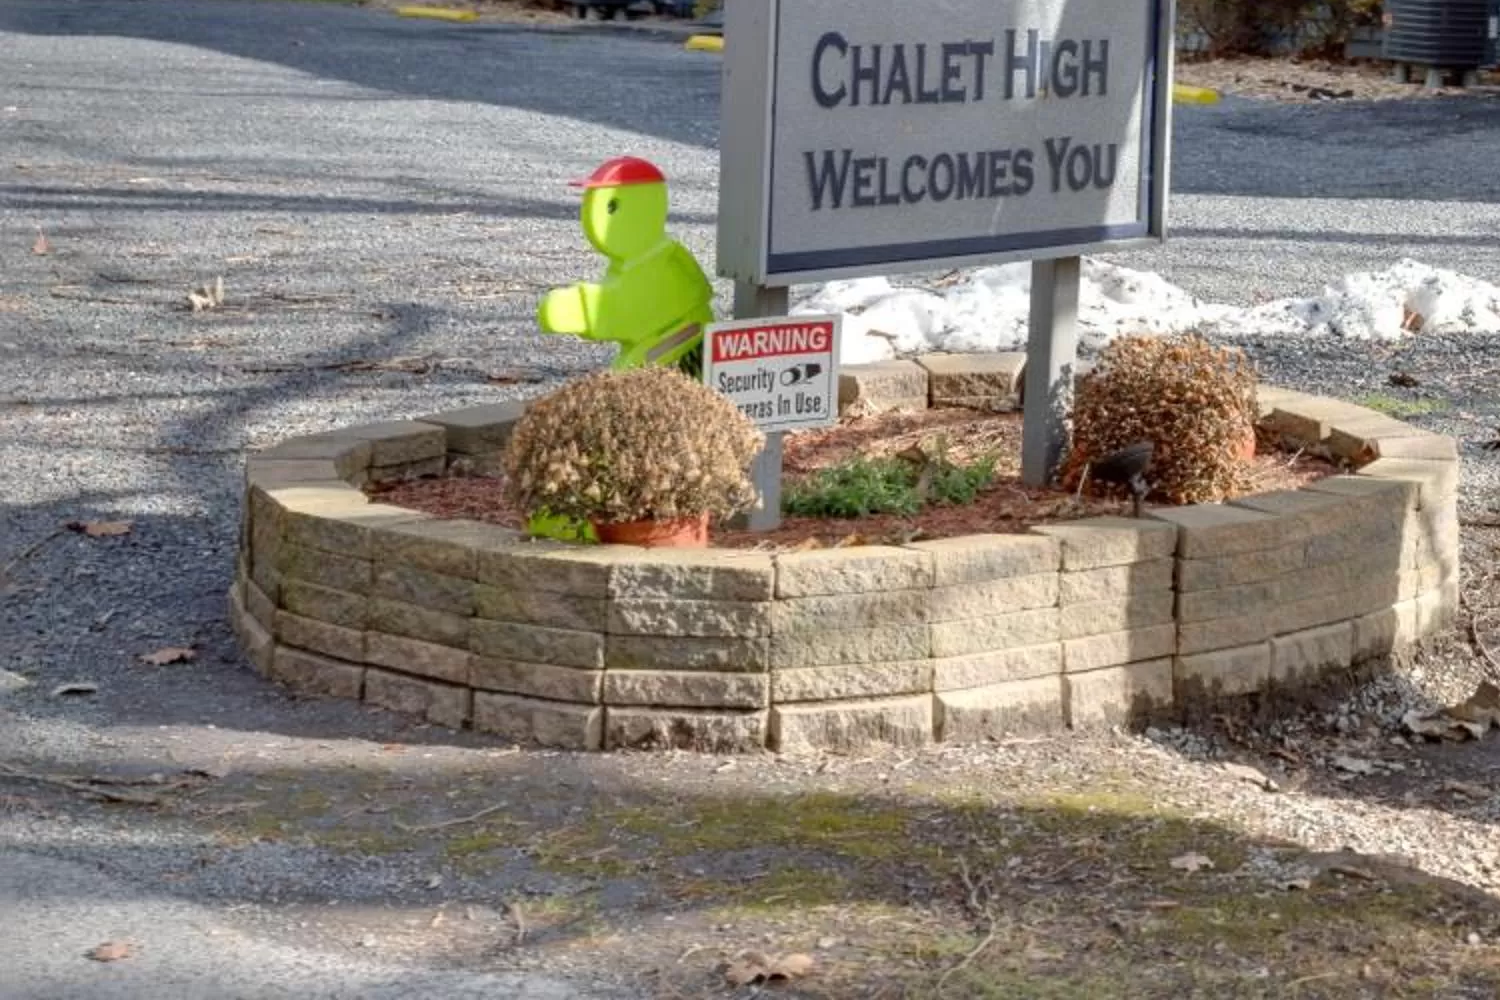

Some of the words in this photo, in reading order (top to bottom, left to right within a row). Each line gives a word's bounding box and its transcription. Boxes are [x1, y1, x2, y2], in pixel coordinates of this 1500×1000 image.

[812, 31, 994, 108] CHALET
[1004, 28, 1110, 100] HIGH
[803, 149, 1034, 211] WELCOMES
[1044, 136, 1118, 193] YOU
[718, 327, 827, 359] WARNING
[718, 369, 775, 394] Security
[777, 394, 791, 416] In
[795, 392, 821, 414] Use
